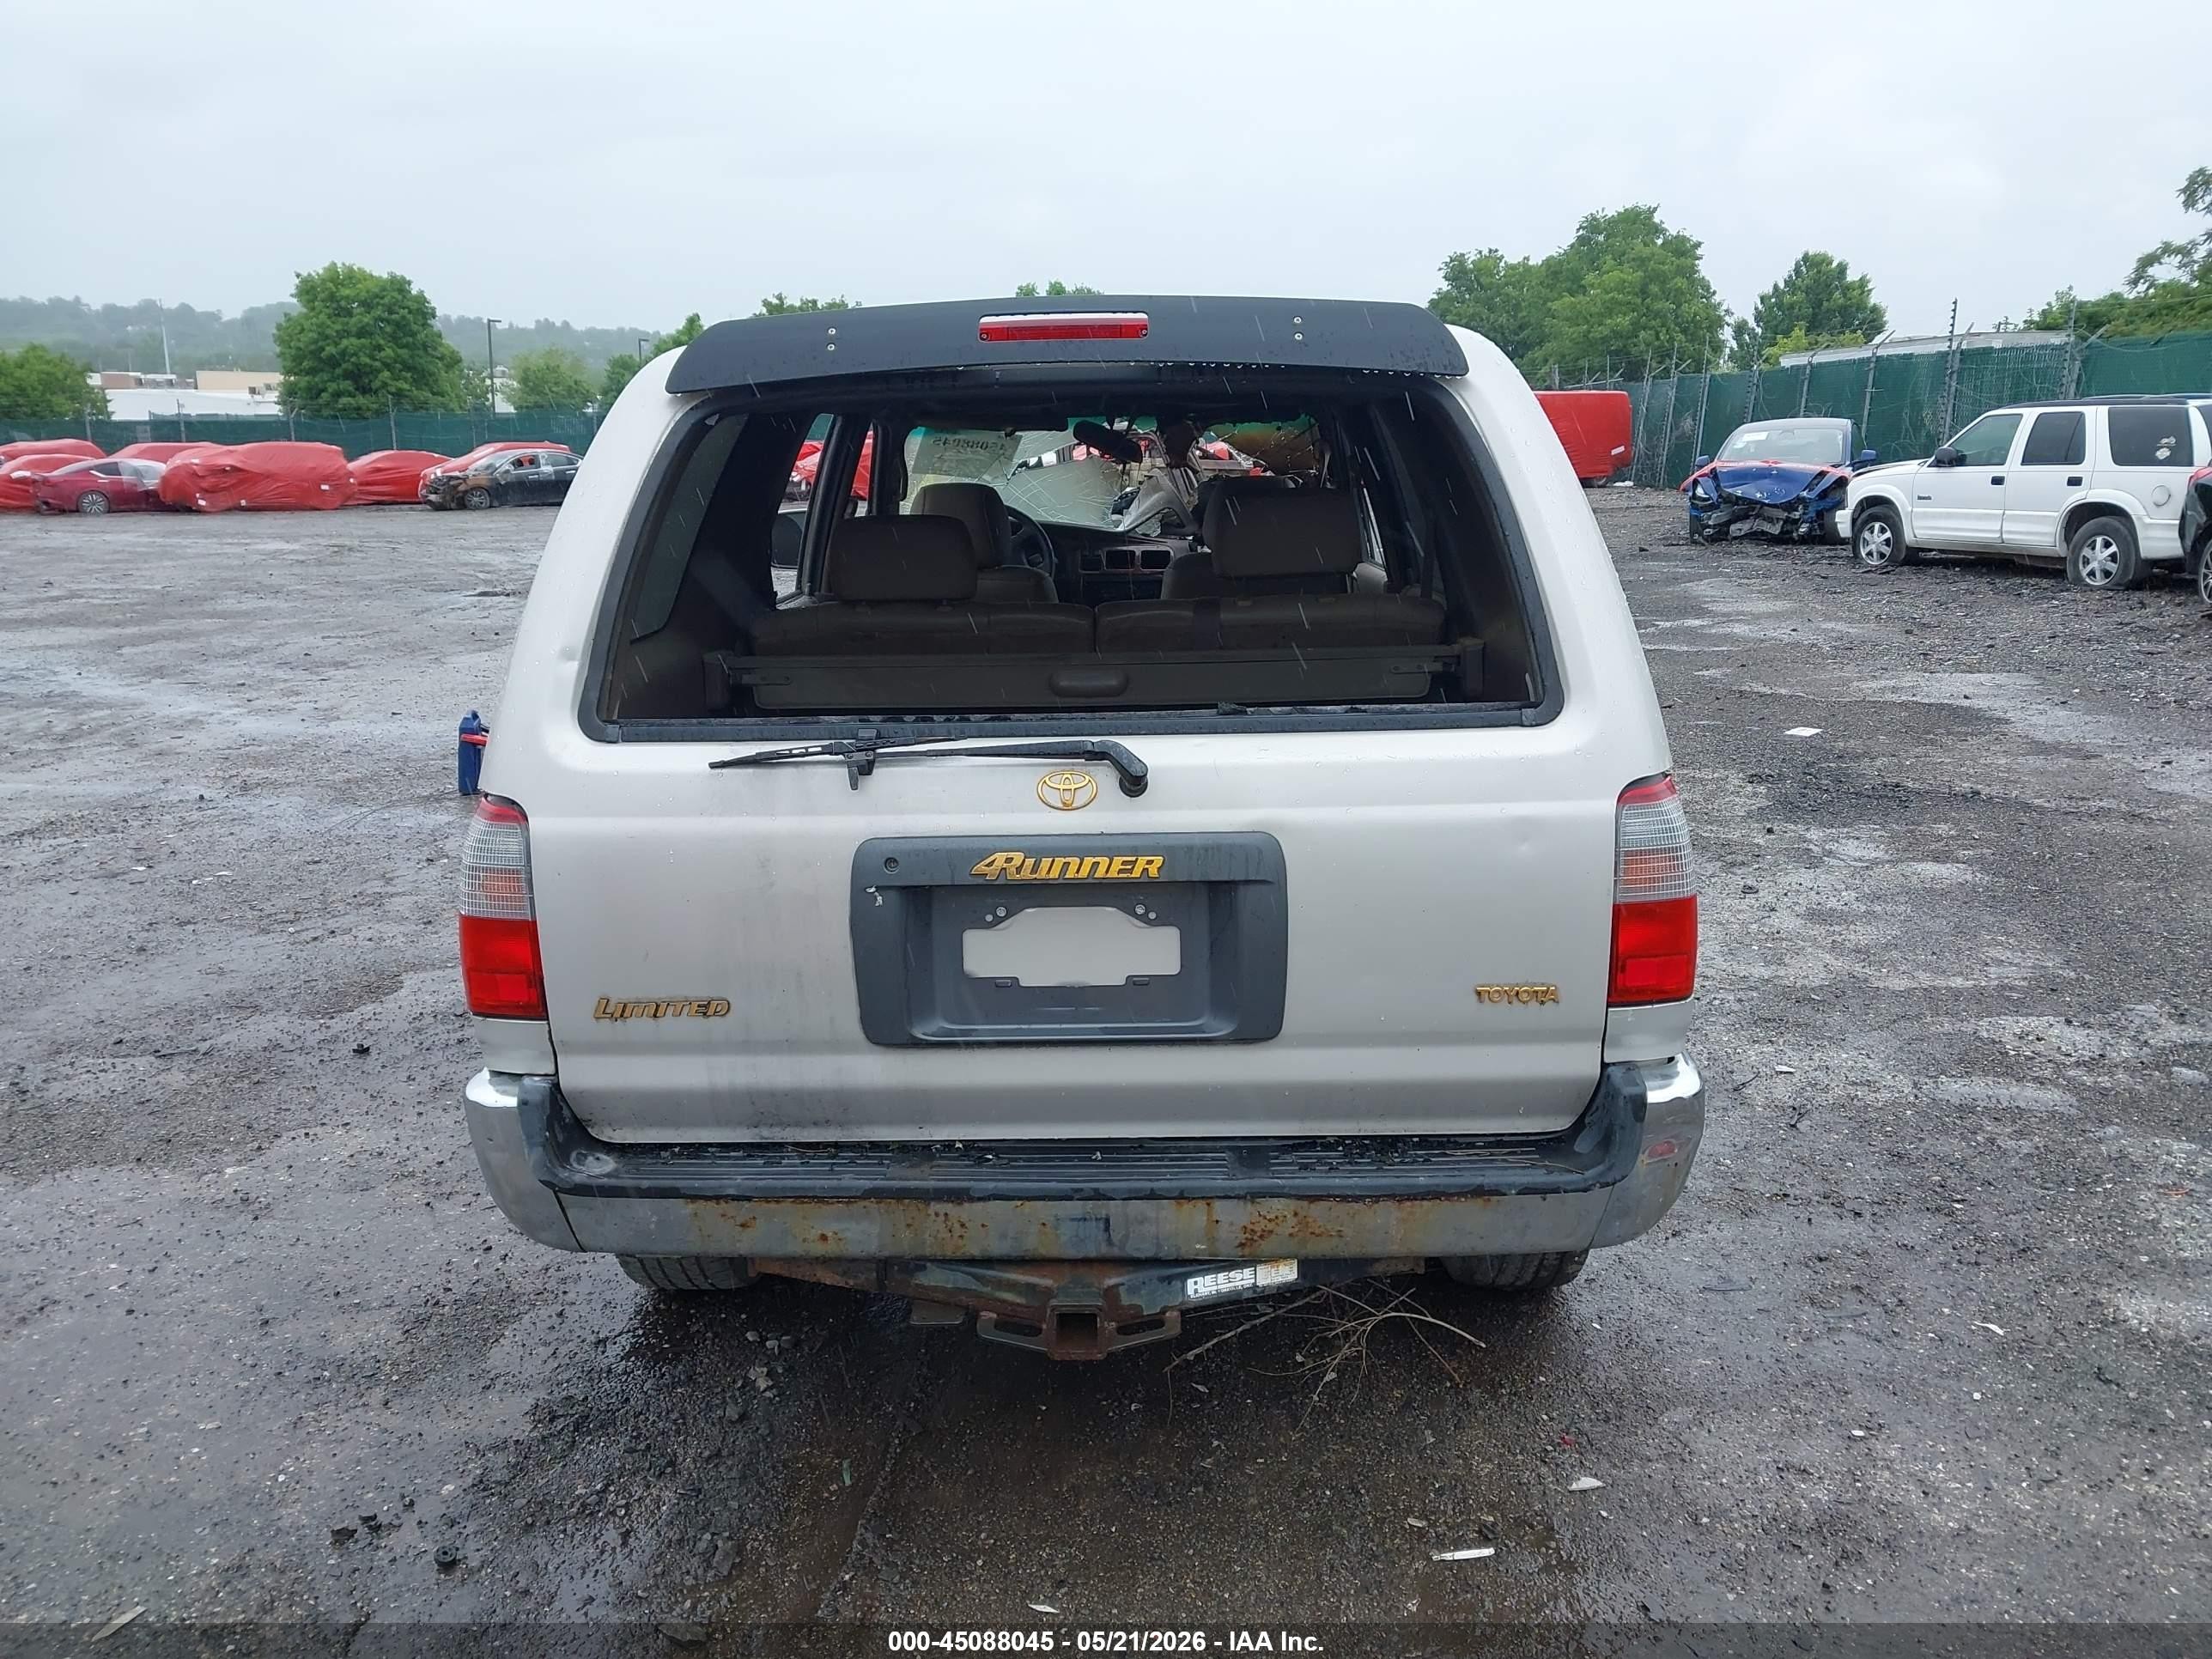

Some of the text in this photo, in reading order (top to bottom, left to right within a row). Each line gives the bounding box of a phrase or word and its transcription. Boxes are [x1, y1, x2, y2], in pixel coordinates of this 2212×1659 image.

[1476, 986, 1559, 1004] TOYOTA
[593, 998, 731, 1019] LIMITED
[1187, 1267, 1255, 1295] REESE
